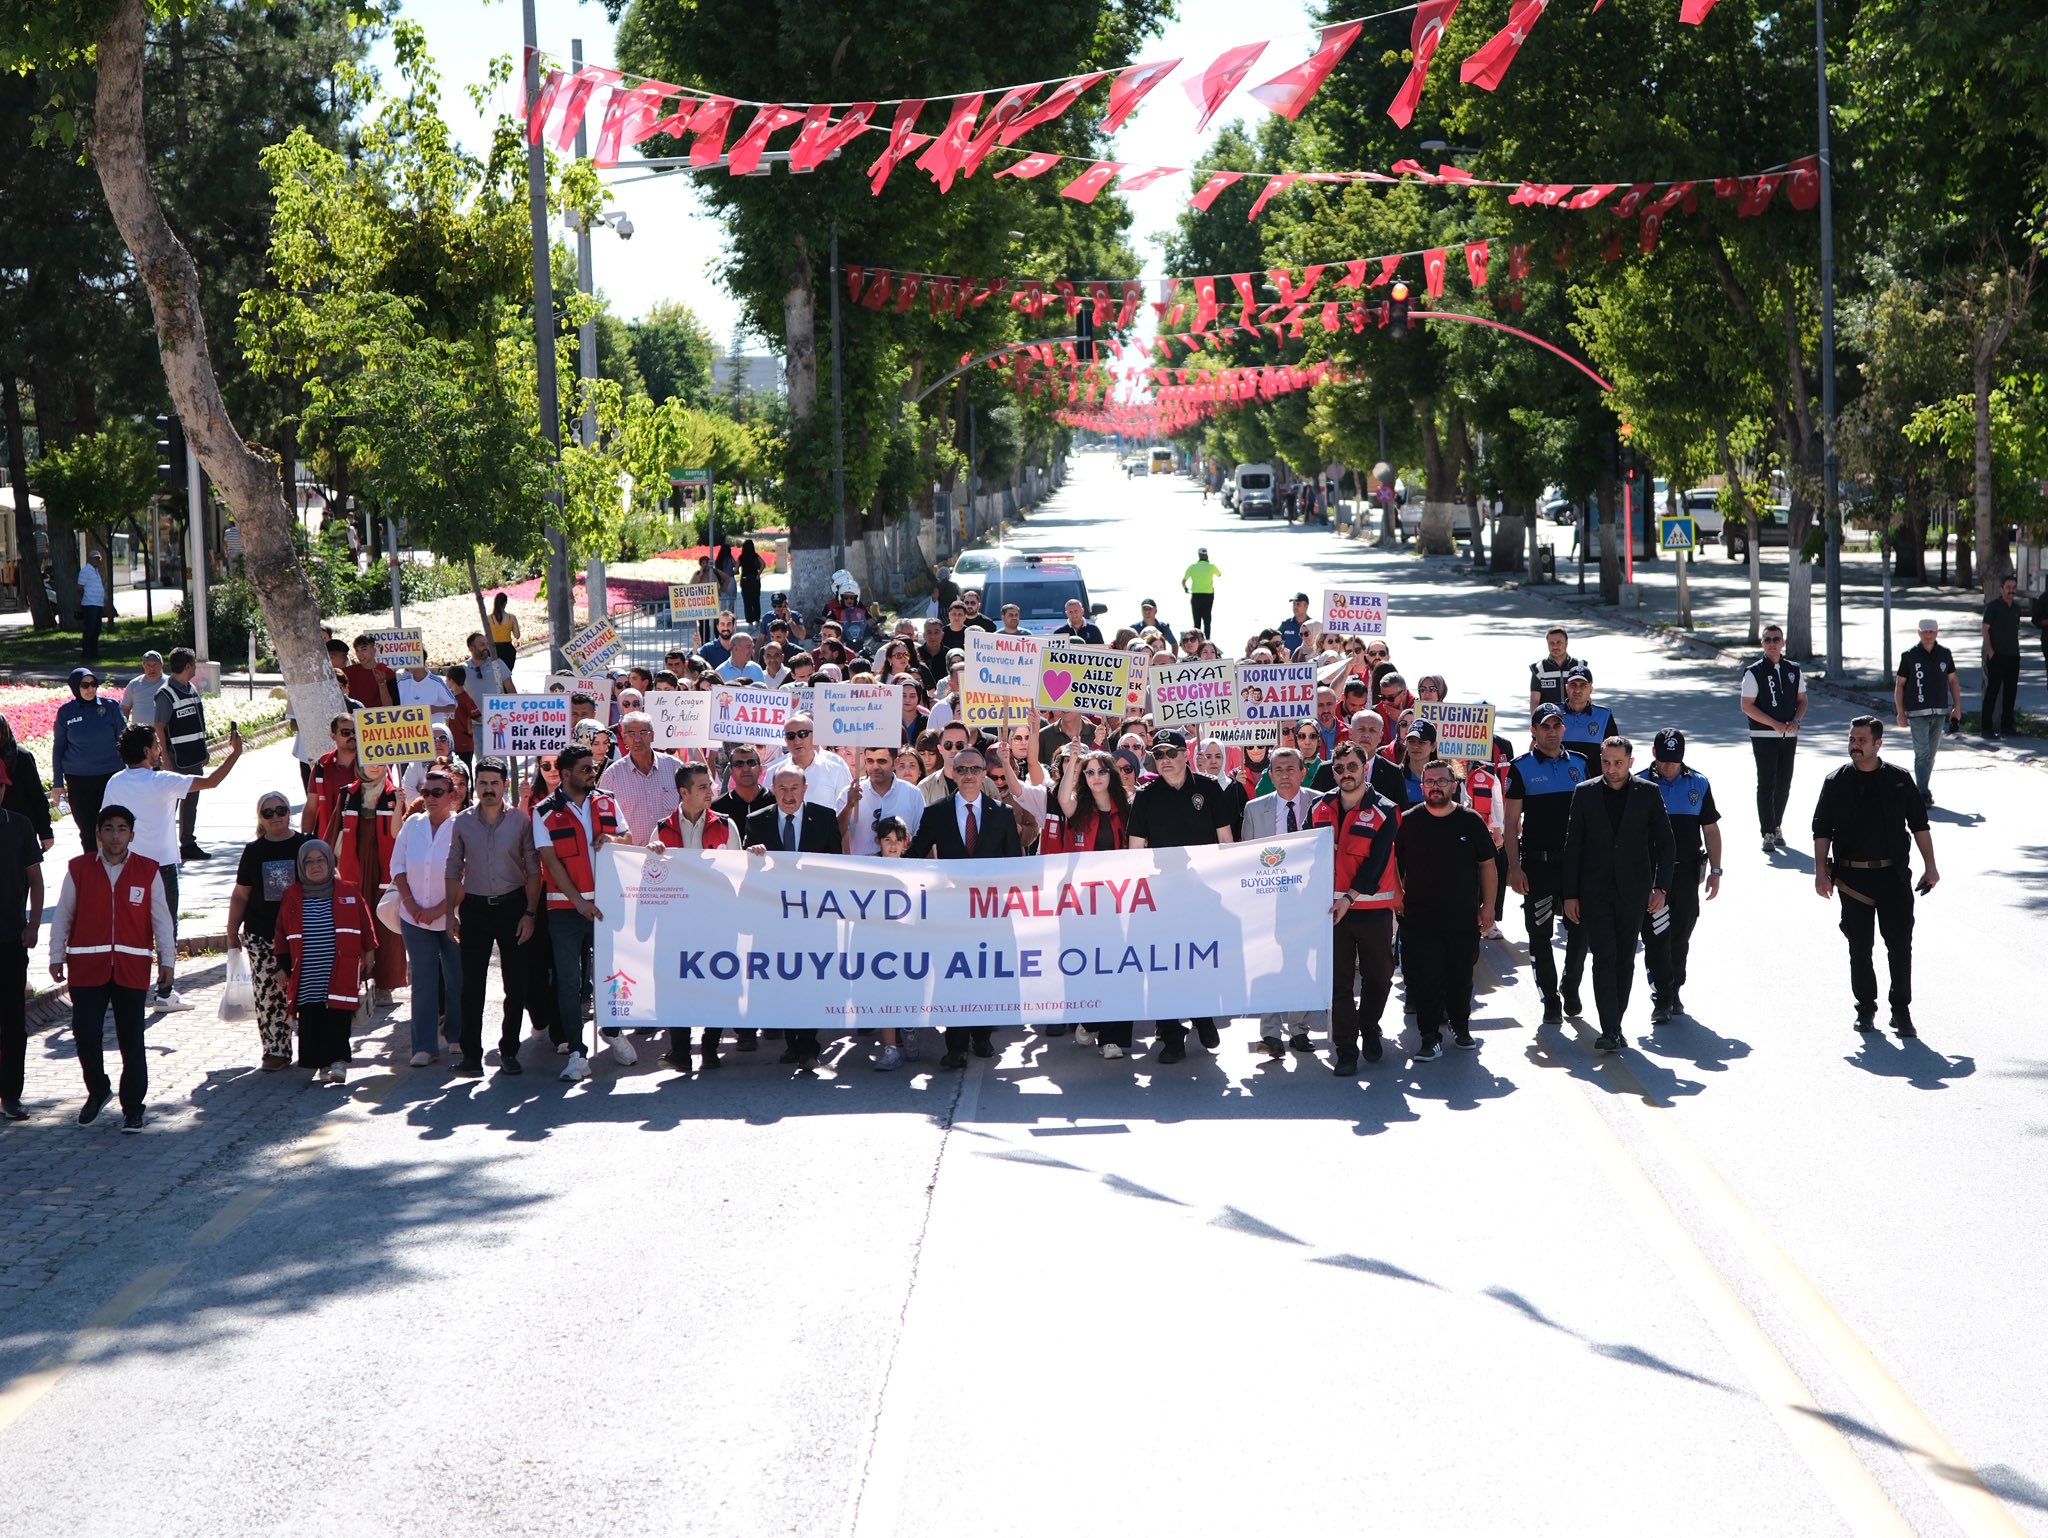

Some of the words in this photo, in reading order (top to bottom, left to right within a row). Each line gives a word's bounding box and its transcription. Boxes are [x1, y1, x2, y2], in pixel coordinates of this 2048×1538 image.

[1349, 596, 1382, 606] HER
[1330, 608, 1382, 620] ÇOCUĞA
[996, 638, 1037, 653] MALATYA
[1050, 652, 1122, 668] KORUYUCU
[1160, 666, 1226, 684] HAYAT
[1244, 667, 1312, 682] KORUYUCU
[850, 686, 892, 699] MALATYA
[1071, 682, 1122, 697] SONSUZ
[489, 699, 516, 710] Her
[522, 699, 565, 711] çocuk
[735, 693, 789, 706] KORUYUCU
[509, 712, 539, 724] Sevgi
[543, 711, 566, 722] Dolu
[660, 709, 675, 722] Bir
[1247, 704, 1311, 719] OLALIM
[362, 725, 429, 742] PAYLAŞINCA
[511, 726, 528, 737] Bir
[533, 725, 566, 737] Aileyi
[714, 722, 741, 735] GÜÇLÜ
[1442, 723, 1488, 739] ÇOCUĞA
[365, 741, 430, 760] ÇOĞALIR
[512, 740, 536, 750] Hak
[540, 740, 566, 750] Eder
[1256, 868, 1287, 876] MALATYA
[1241, 875, 1302, 888] BÜYÜKŞEHİR
[780, 884, 926, 920] HAYDİ
[969, 878, 1157, 919] MALATYA
[679, 950, 931, 980] KORUYUCU
[944, 942, 1042, 978] AİLE
[1057, 941, 1219, 976] OLALIM
[611, 1007, 630, 1016] aile
[825, 1005, 874, 1014] MALATYA
[878, 1004, 902, 1014] AİLE
[904, 1005, 917, 1013] VE
[920, 1004, 958, 1013] SOSYAL
[960, 1002, 1021, 1013] HİZMETLER
[1023, 1001, 1033, 1011] İL
[1036, 1000, 1102, 1010] MÜDÜRLÜĞÜ
